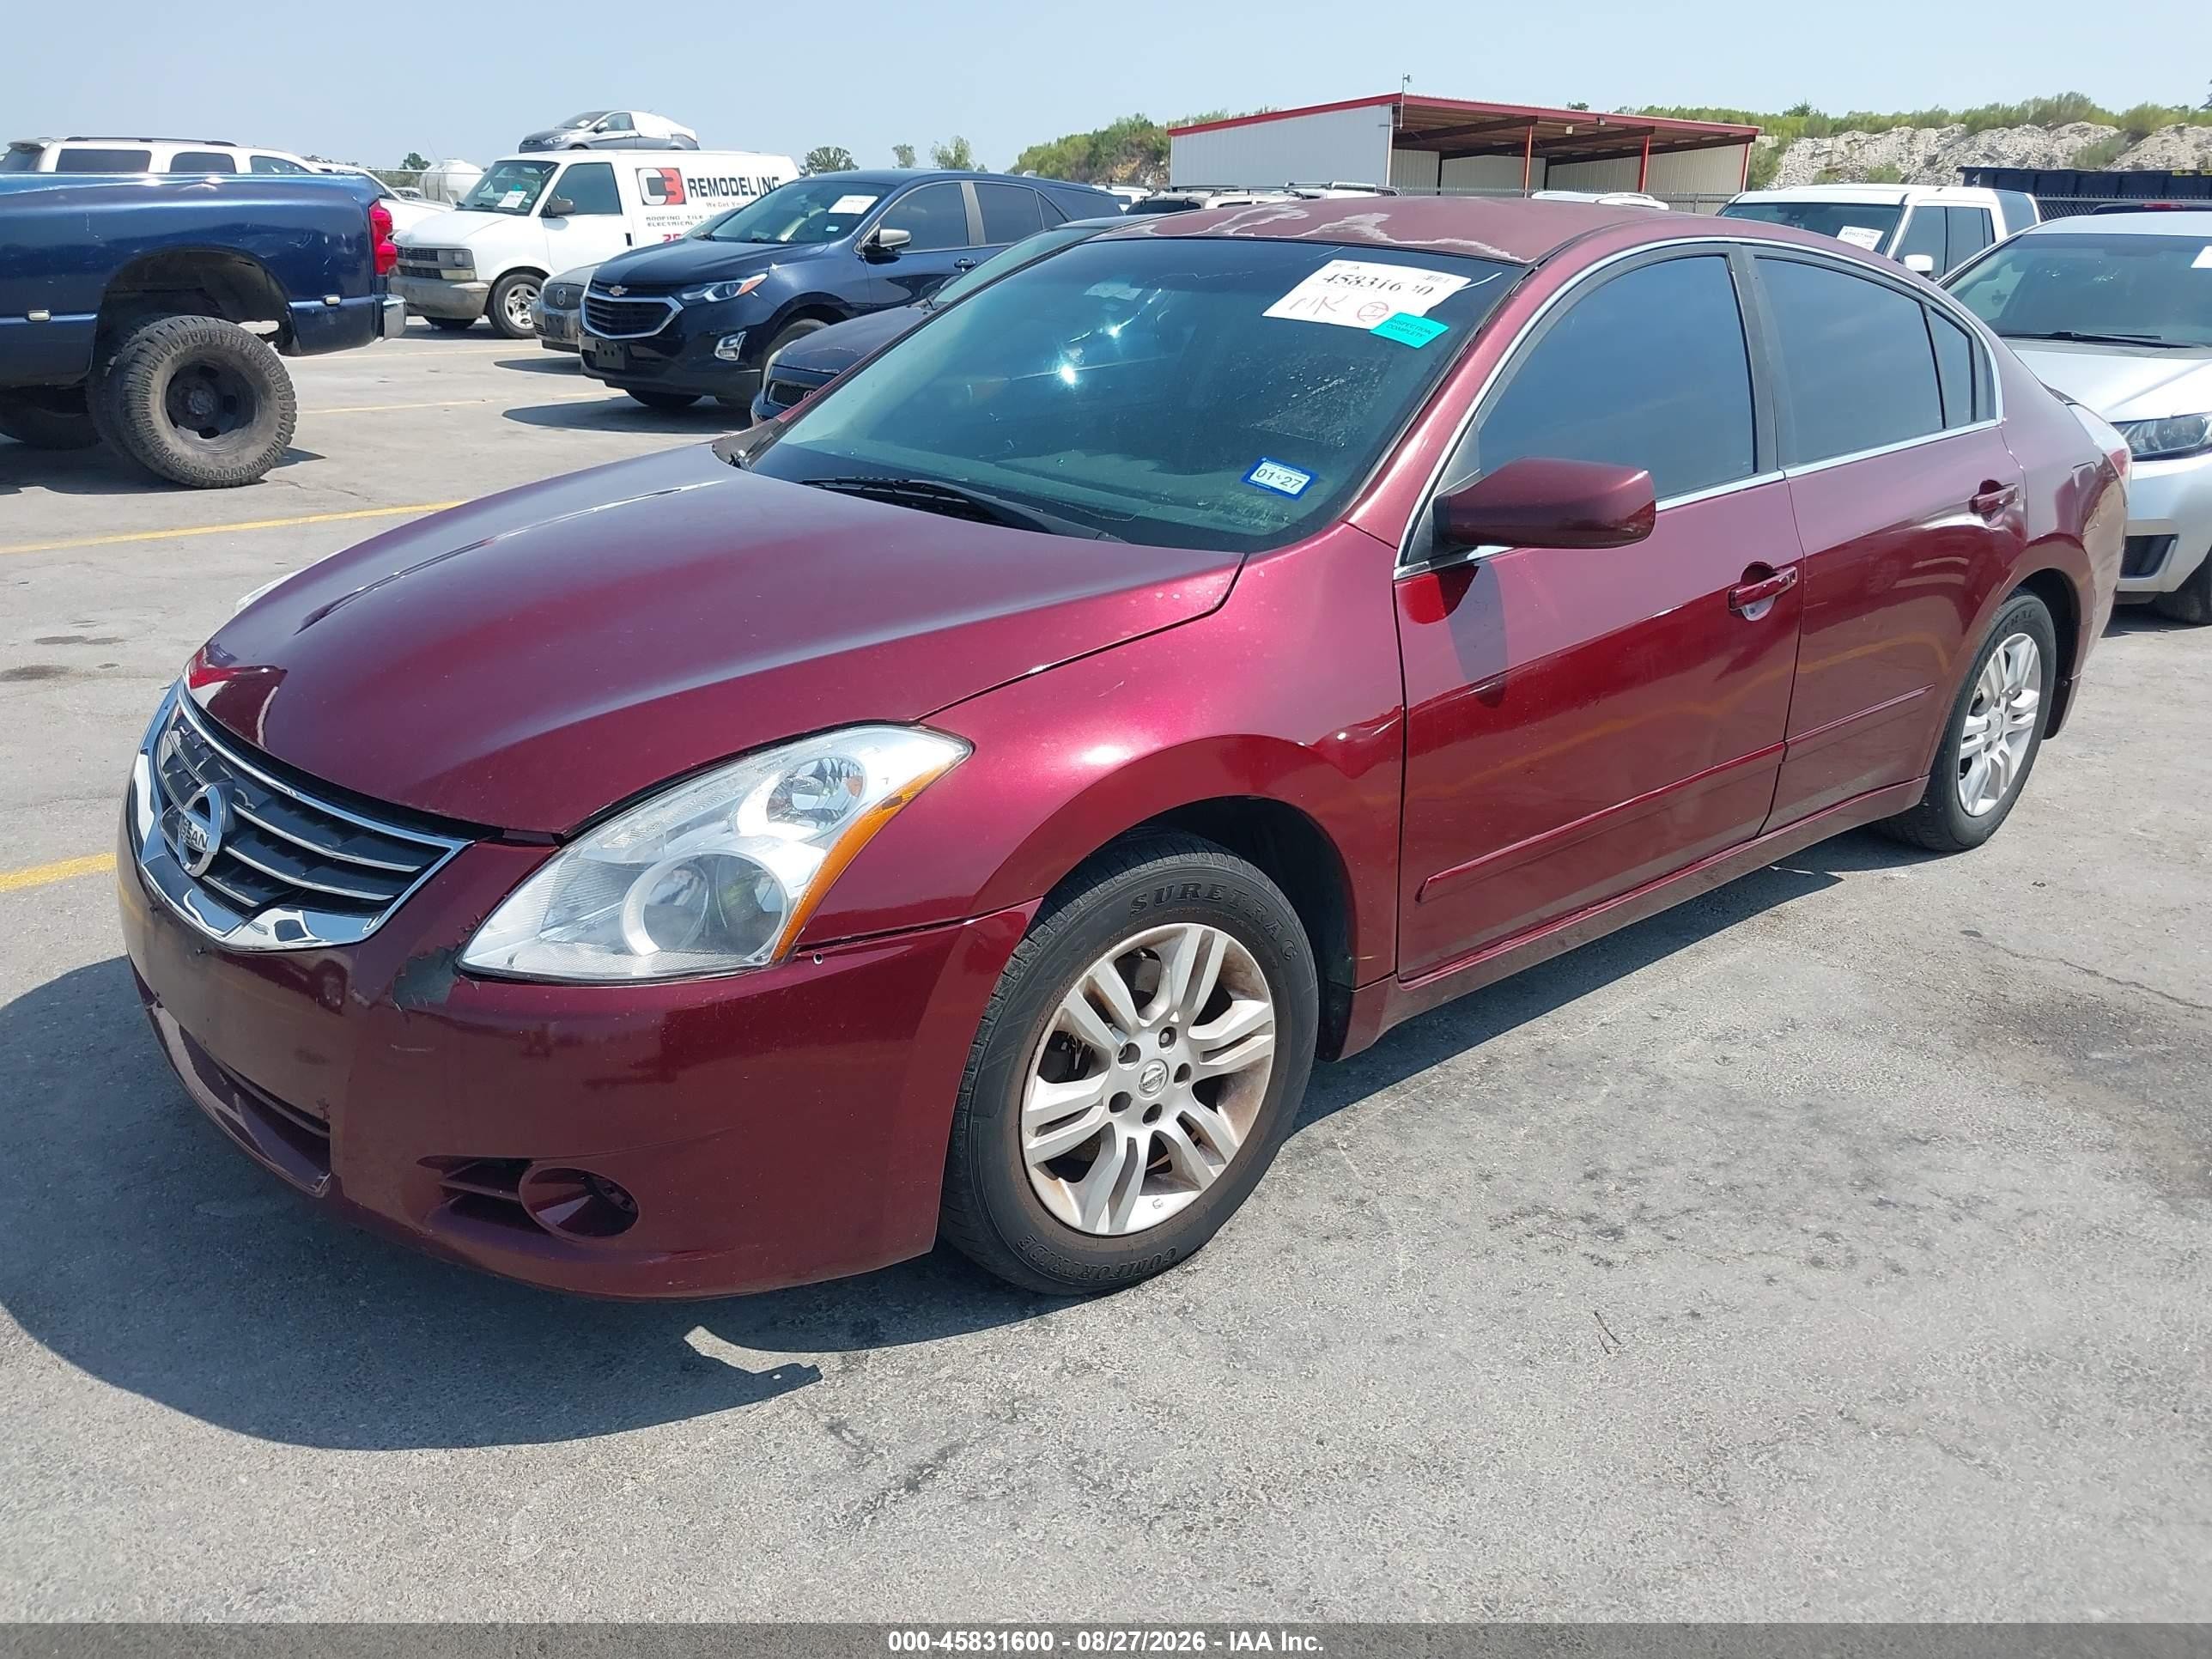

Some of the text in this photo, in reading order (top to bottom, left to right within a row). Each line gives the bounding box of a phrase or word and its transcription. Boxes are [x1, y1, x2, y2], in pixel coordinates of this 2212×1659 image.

[687, 176, 781, 198] REMODELING
[1322, 273, 1434, 296] 4583160
[1255, 468, 1276, 481] 01
[1279, 476, 1303, 489] 27
[1129, 883, 1298, 961] SURETRAC
